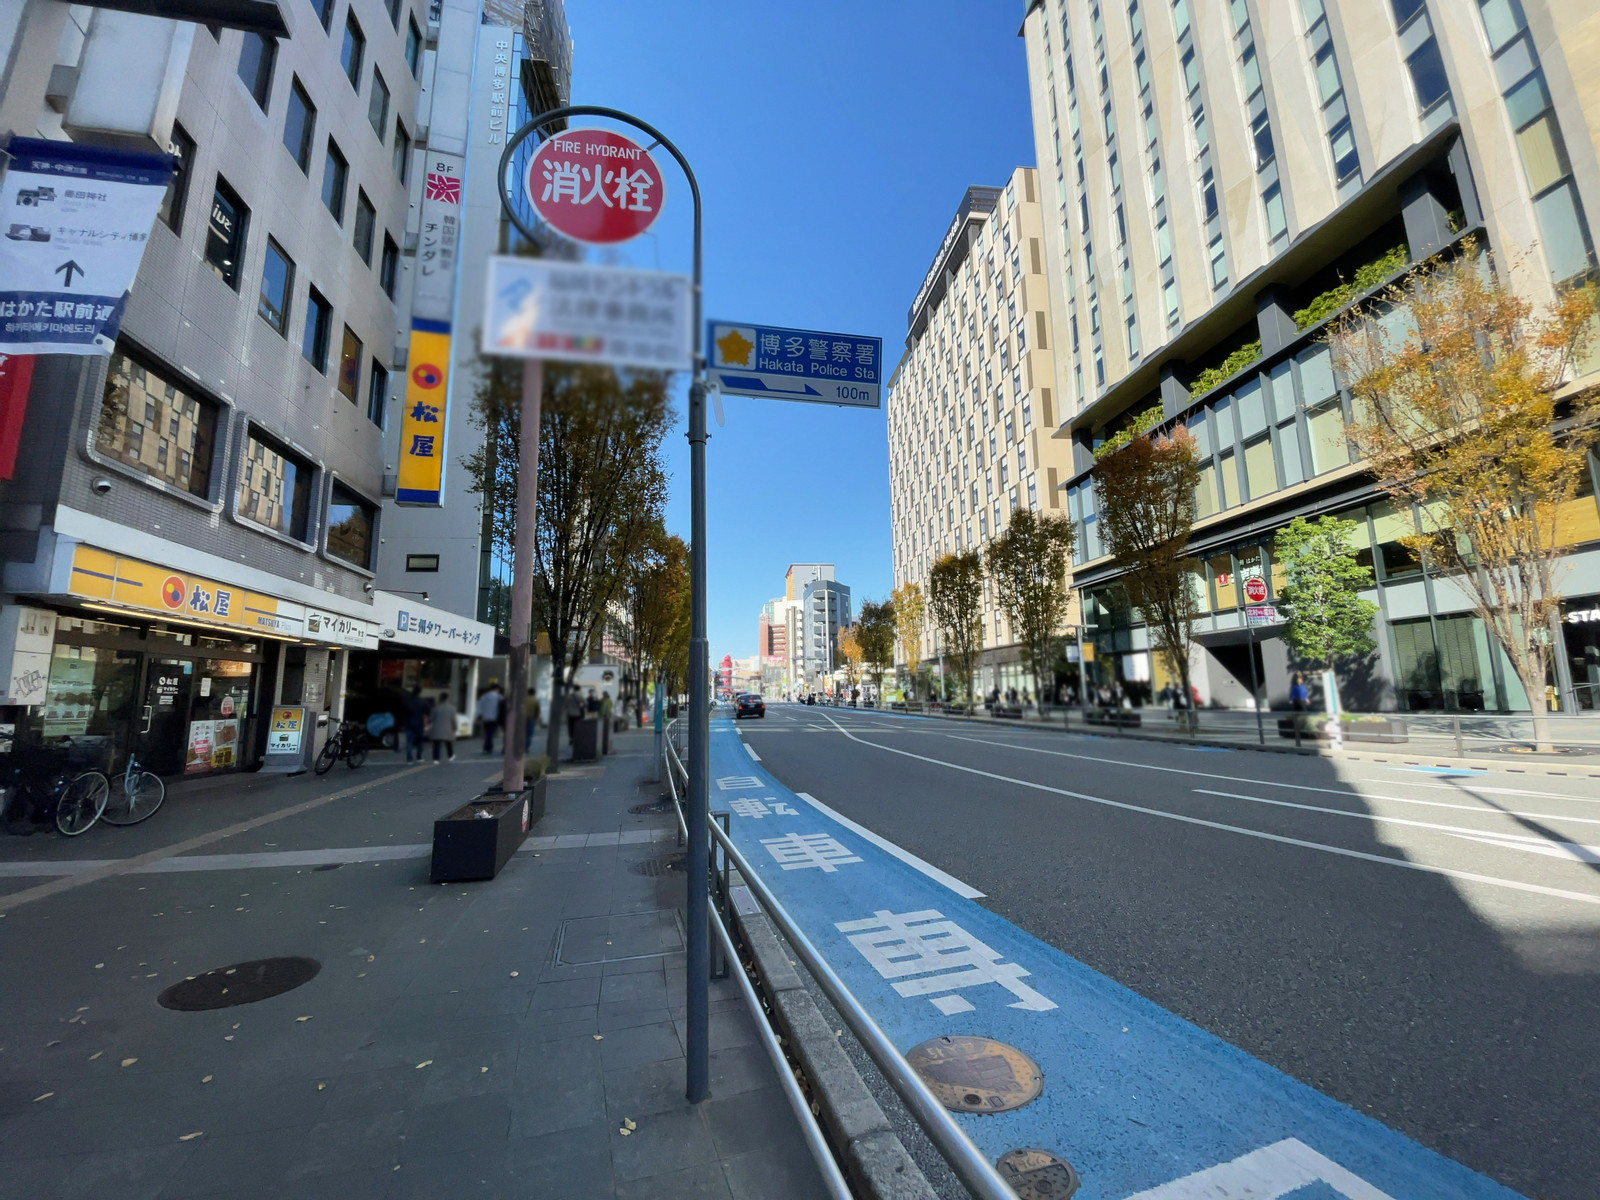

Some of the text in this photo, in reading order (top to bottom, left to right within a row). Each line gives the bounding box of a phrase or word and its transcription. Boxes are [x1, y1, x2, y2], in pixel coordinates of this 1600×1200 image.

[489, 40, 508, 145] 中央博多駅前ビル
[553, 140, 642, 161] FIRE HYDRANT
[435, 162, 454, 173] 8F
[541, 159, 654, 212] 消火栓
[421, 222, 438, 276] チンダレ
[760, 333, 875, 366] 博多警察署
[759, 358, 804, 373] Hakata
[811, 362, 848, 377] Police
[836, 386, 870, 401] 100m
[409, 401, 440, 458] 松屋
[189, 584, 232, 617] 松屋
